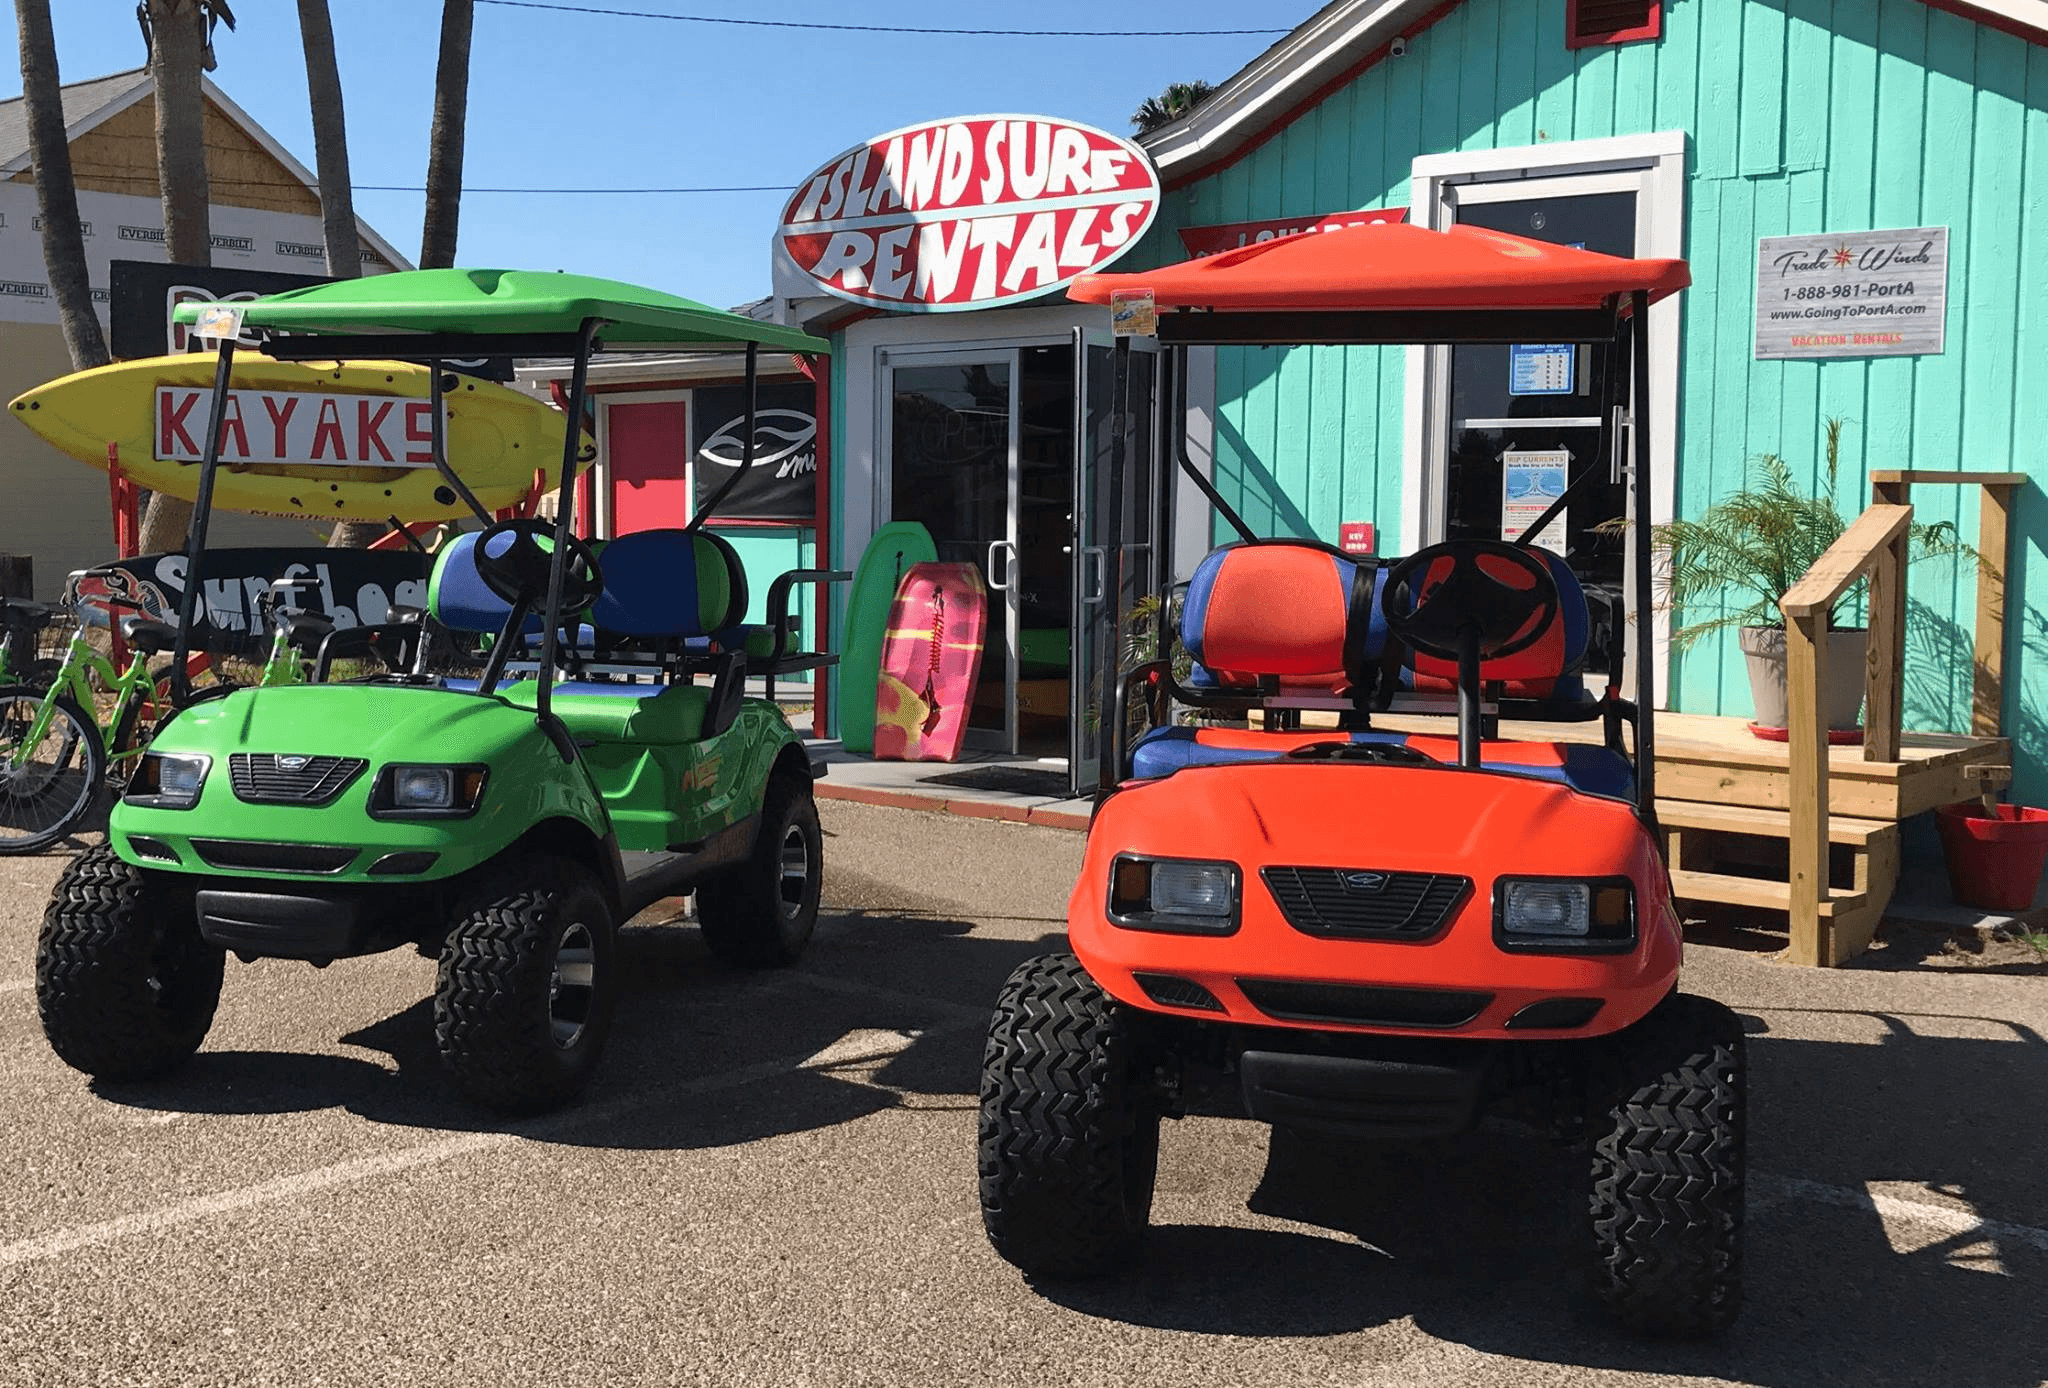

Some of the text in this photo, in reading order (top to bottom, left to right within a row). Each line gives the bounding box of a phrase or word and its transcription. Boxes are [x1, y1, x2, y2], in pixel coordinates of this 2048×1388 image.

[794, 119, 1132, 222] ISLAND SURF
[121, 228, 166, 241] EVERBIL
[209, 236, 250, 249] VERBILT
[810, 202, 1143, 302] RENTALS
[1773, 241, 1933, 278] Trade Winds
[0, 283, 45, 296] VERBILT
[1784, 281, 1915, 301] 1-888-981-PortA
[1770, 304, 1926, 320] www.GoingToPortA.com
[161, 392, 434, 463] KAYAKS
[155, 555, 428, 637] Surfboa
